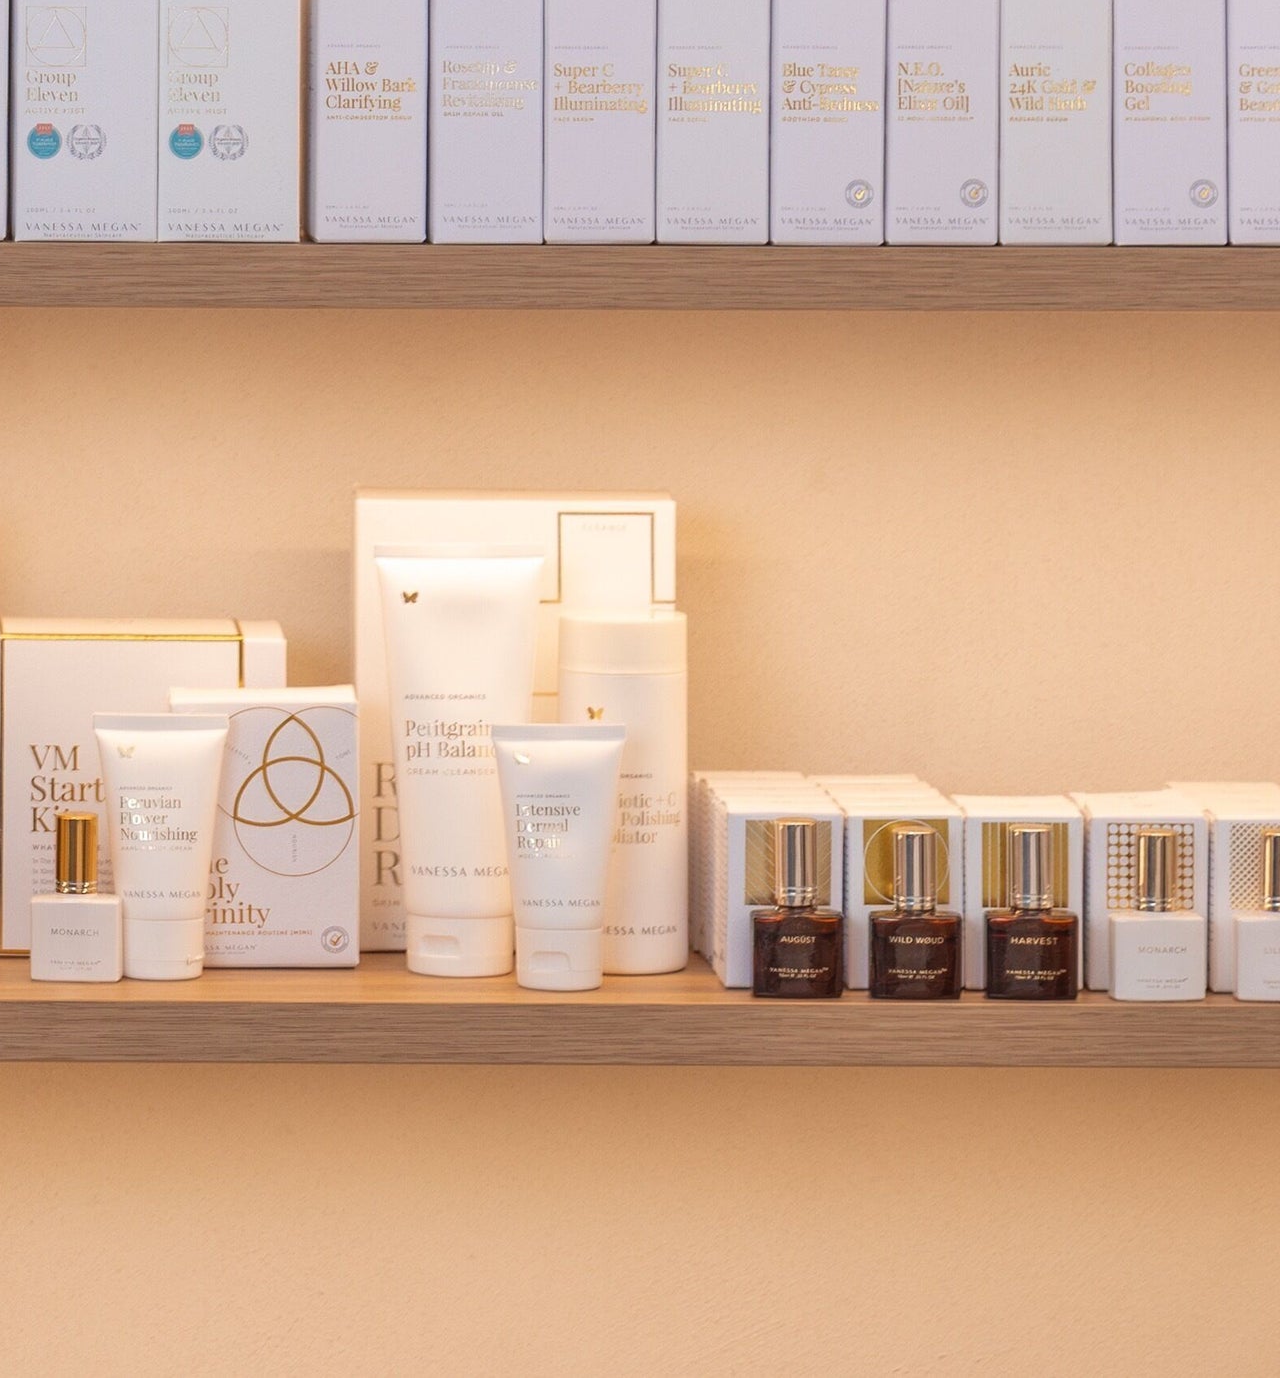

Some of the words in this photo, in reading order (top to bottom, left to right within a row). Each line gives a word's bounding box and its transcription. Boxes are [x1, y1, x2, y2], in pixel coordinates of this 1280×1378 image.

[326, 61, 360, 75] AHA
[364, 61, 379, 75] &
[554, 64, 598, 79] Super
[782, 64, 814, 77] Blue
[897, 63, 944, 77] N.E.O.
[326, 78, 378, 92] Willow
[381, 78, 417, 92] Bark
[567, 81, 644, 97] Bearberry
[782, 81, 795, 94] &
[326, 96, 401, 111] Clarifying
[554, 97, 648, 114] Illuminating
[668, 97, 762, 114] Illuminating
[1124, 96, 1150, 111] Gel
[30, 744, 79, 772] VM
[119, 796, 181, 809] Peruvian
[516, 802, 581, 817] Intensive
[120, 812, 168, 826] Flower
[516, 819, 569, 833] Dermal
[621, 811, 681, 828] Polishing
[120, 828, 198, 844] Nourishing
[51, 928, 99, 937] MONARCH
[889, 935, 912, 945] WILD
[1011, 936, 1058, 946] HARVEST
[1137, 945, 1188, 954] MONARCH
